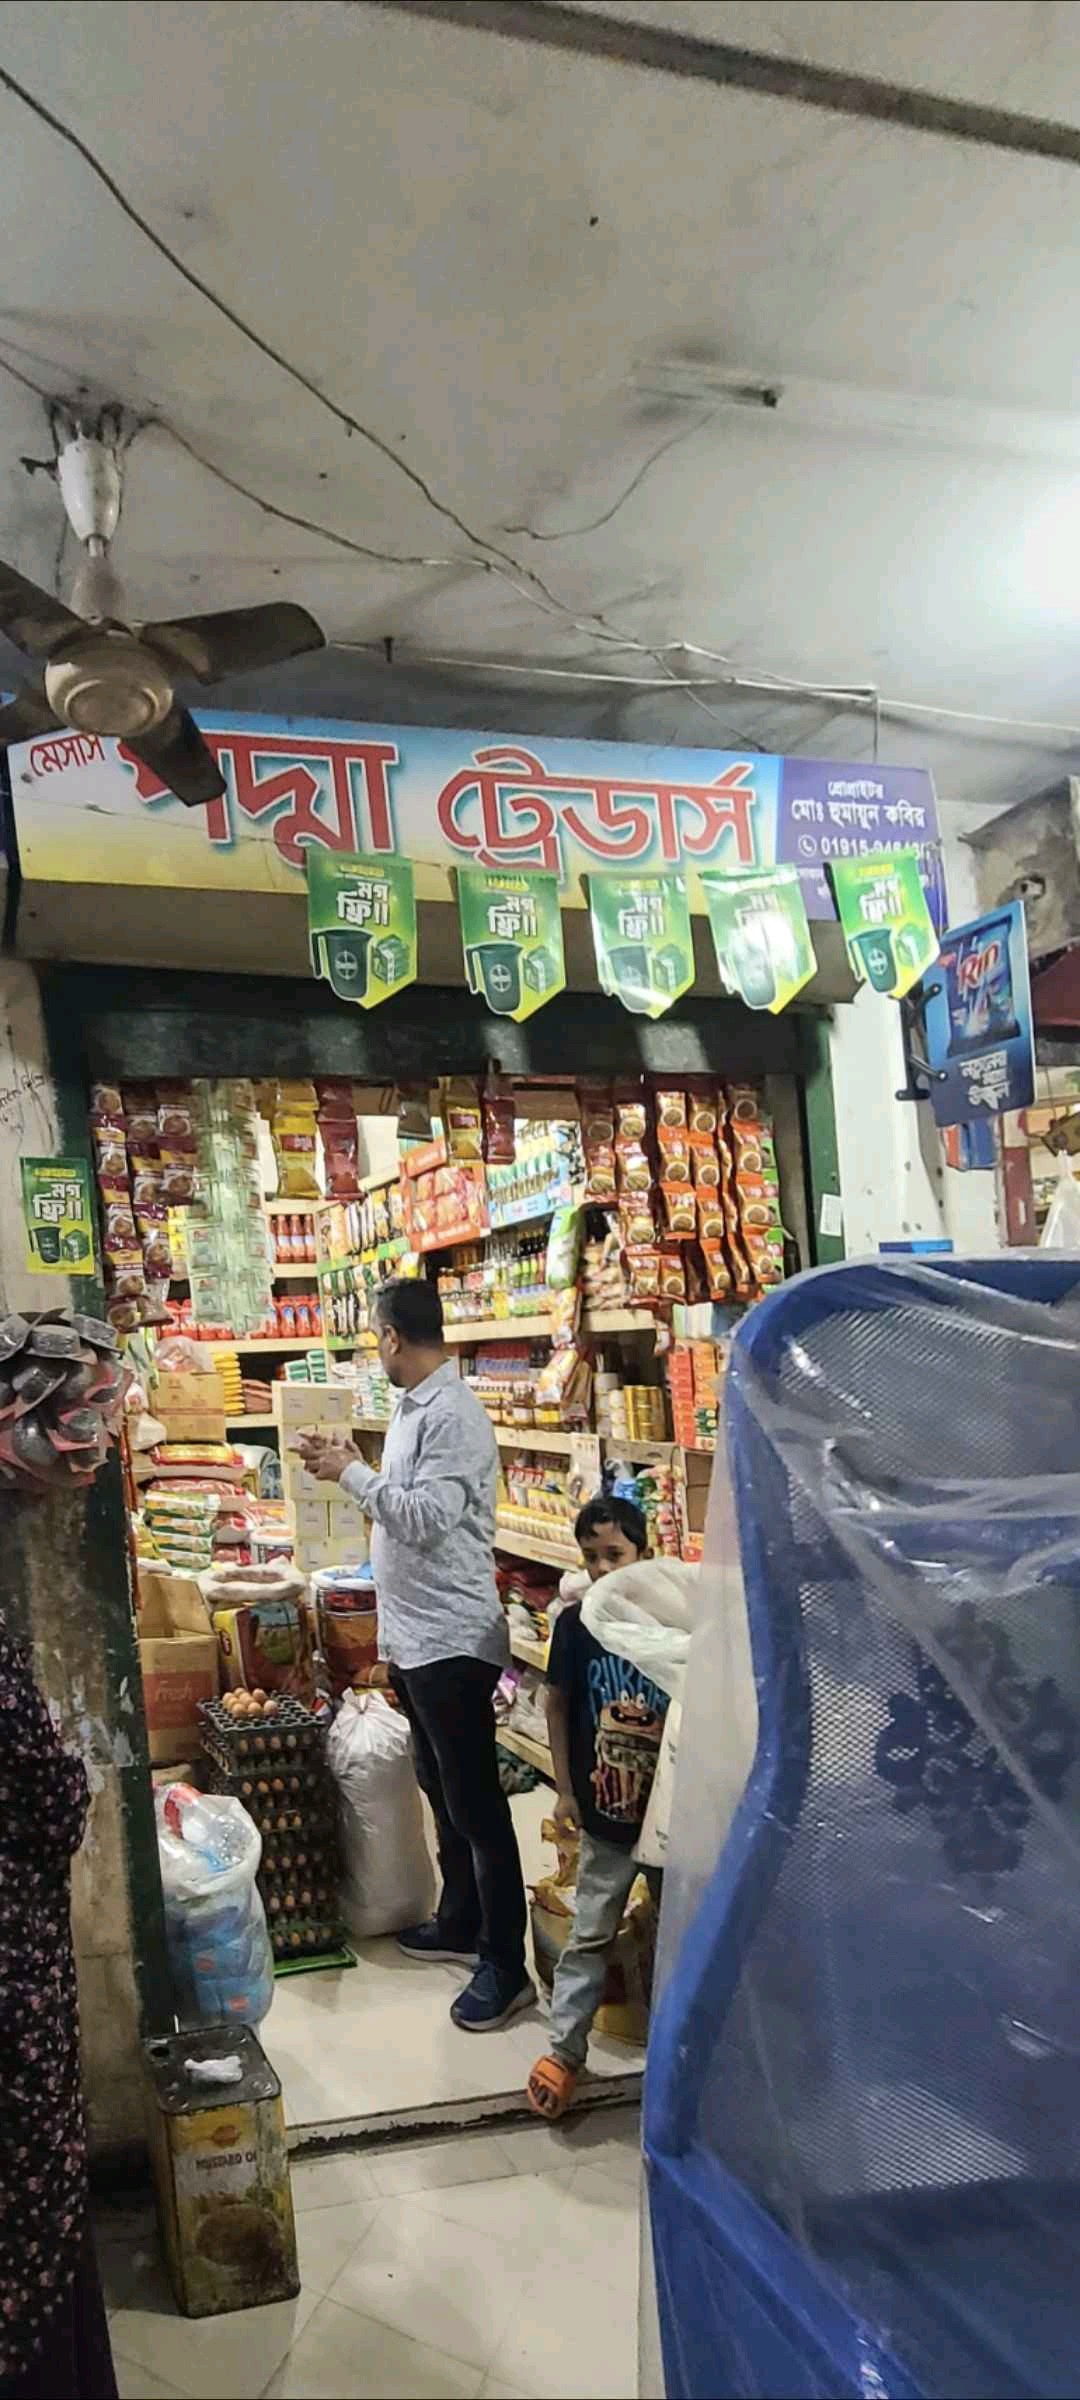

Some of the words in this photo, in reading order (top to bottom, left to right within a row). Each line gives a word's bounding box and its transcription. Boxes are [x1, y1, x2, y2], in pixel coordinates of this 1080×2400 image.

[437, 744, 755, 882] ট্রেডার্স
[882, 799, 925, 828] কবির
[357, 881, 389, 902] মগ
[50, 1182, 81, 1201] মগ
